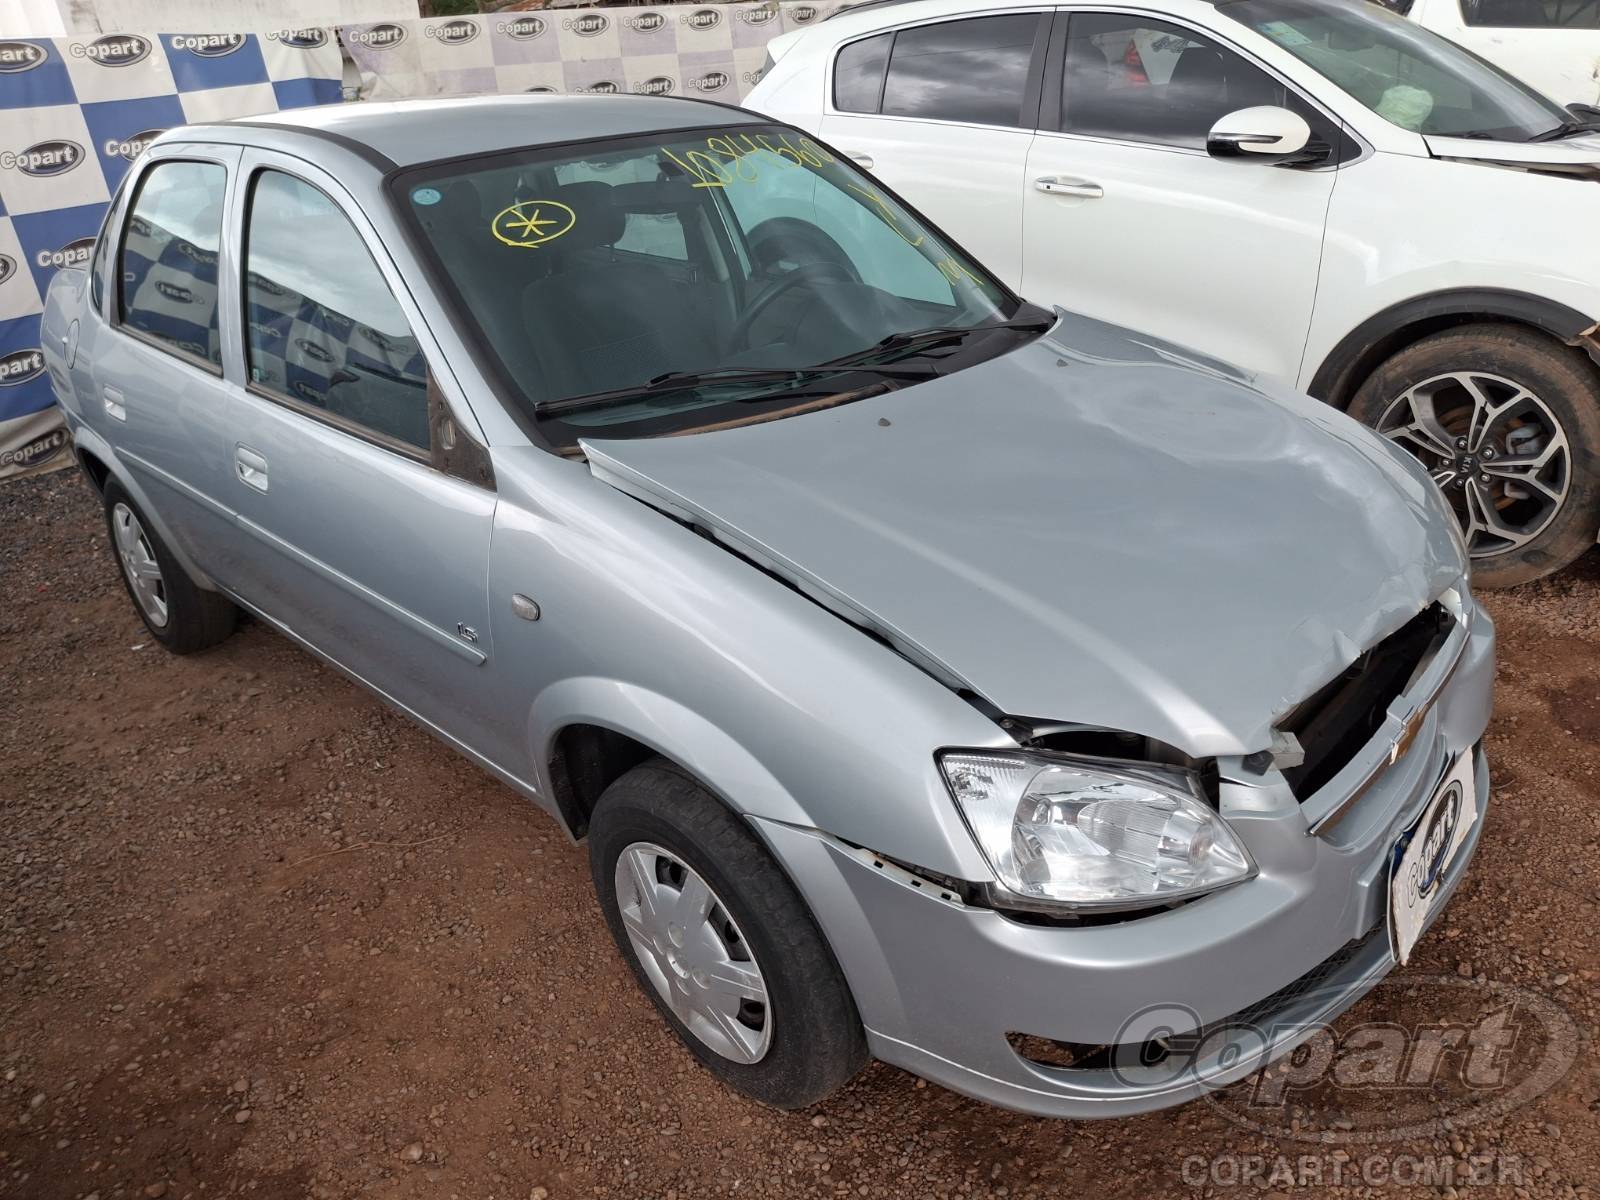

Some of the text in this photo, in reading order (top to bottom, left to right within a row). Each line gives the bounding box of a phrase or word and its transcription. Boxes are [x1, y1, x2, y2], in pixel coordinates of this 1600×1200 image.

[623, 16, 662, 31] Copart
[680, 12, 716, 28] Copart
[735, 8, 773, 24] Copart
[425, 22, 475, 42] Copart
[496, 20, 542, 37] Copart
[562, 17, 604, 35] Copart
[171, 34, 237, 51] Copart
[349, 25, 401, 47] Copart
[0, 47, 36, 61] art
[69, 39, 140, 60] Copart
[633, 80, 670, 94] Copart
[688, 74, 726, 90] Copart
[0, 144, 74, 170] Copart
[0, 352, 41, 382] part
[0, 432, 61, 465] Copart
[1460, 456, 1472, 473] KIA
[1407, 789, 1455, 908] Copart
